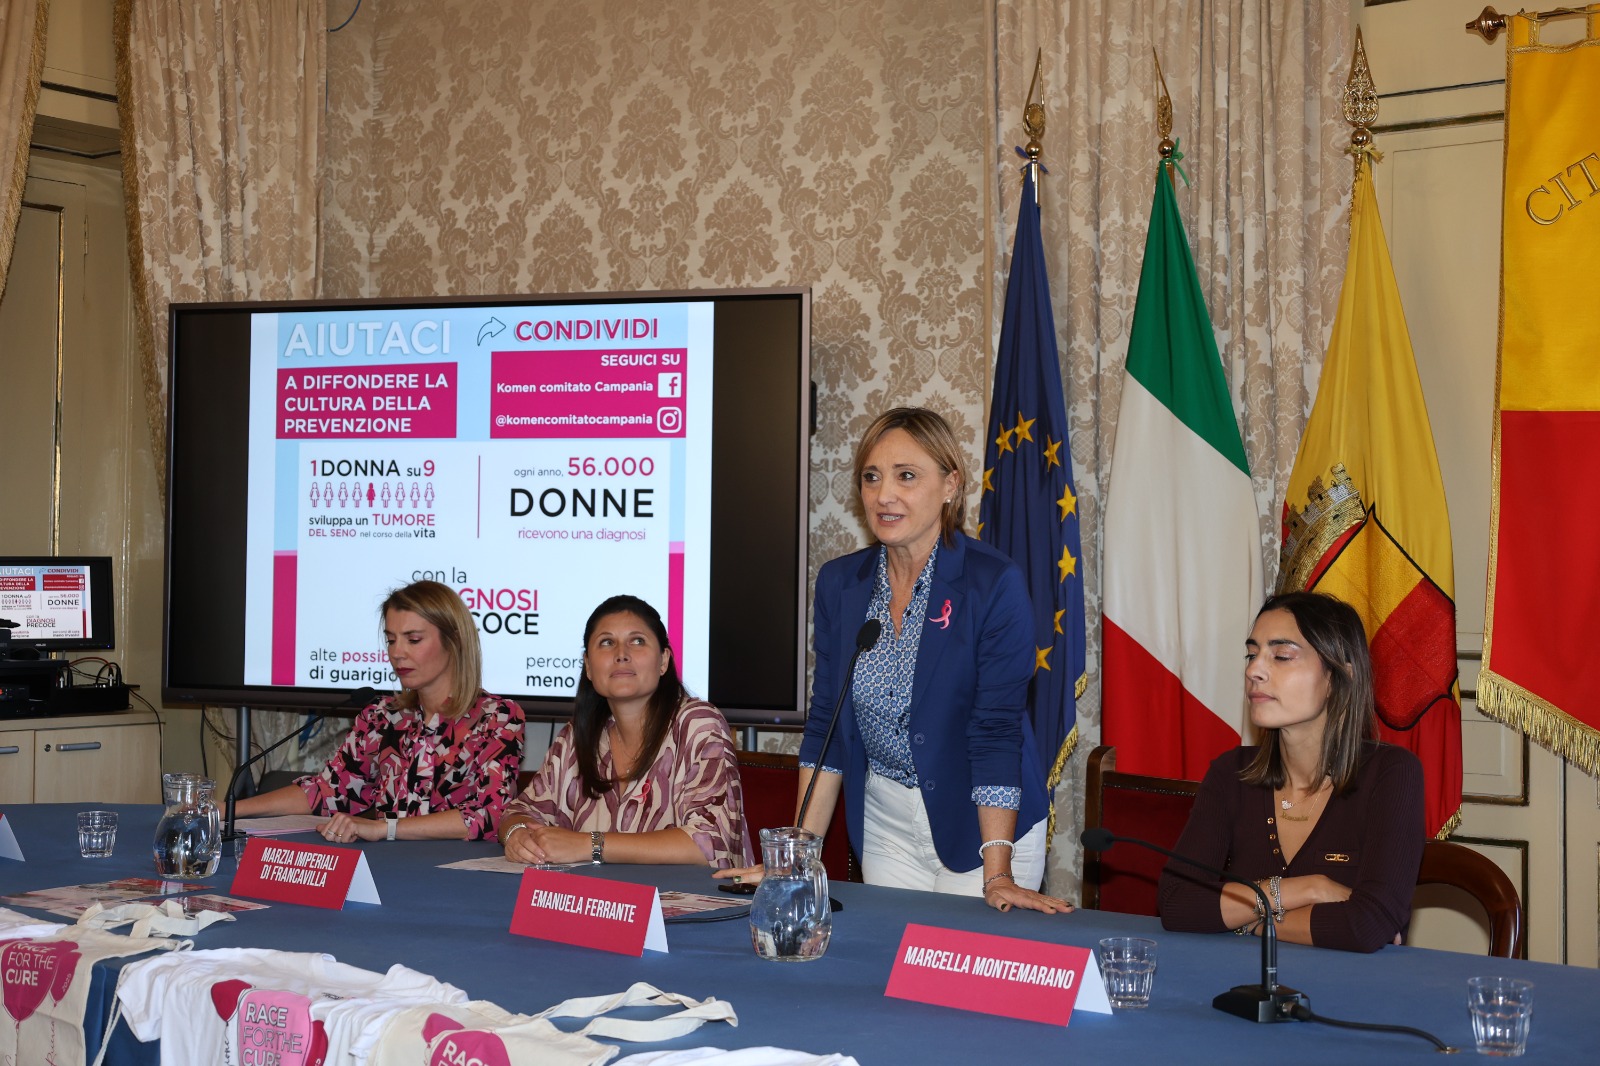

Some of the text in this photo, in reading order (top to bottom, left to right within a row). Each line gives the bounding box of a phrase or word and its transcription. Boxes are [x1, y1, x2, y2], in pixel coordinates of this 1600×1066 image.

[1526, 152, 1600, 225] CIT
[284, 320, 450, 357] AIUTACI
[514, 318, 658, 342] CONDIVIDI
[601, 353, 681, 367] SEGUICI SU
[284, 373, 448, 390] A DIFFONDERE LA
[497, 381, 654, 395] Komen comitato Campania
[284, 396, 431, 412] CULTURA DELLA
[284, 418, 412, 433] PREVENZIONE
[496, 414, 653, 427] @komencomitatocampania
[514, 456, 655, 478] ogni anno, 56.000
[510, 488, 654, 518] DONNE
[309, 514, 436, 527] sviluppa un TUMORE
[308, 528, 327, 537] DEL
[330, 528, 356, 538] SENO
[360, 530, 370, 538] nel
[394, 530, 412, 538] della
[414, 528, 436, 539] vita
[518, 528, 646, 542] ricevono una diagnosi
[412, 566, 466, 584] con la
[458, 588, 538, 611] GNOSI
[310, 648, 389, 664] alte possib
[526, 656, 584, 670] percors
[309, 666, 398, 684] di guarigio
[526, 675, 575, 688] meno
[260, 847, 340, 871] MARZIA IMPERIALI
[260, 864, 328, 888] DI FRANCAVILLA
[530, 889, 637, 923] EMANUELA FERRANTE
[8, 951, 56, 970] FOR THE
[904, 946, 1075, 990] MARCELLA MONTEMARANO
[6, 968, 38, 986] CURE
[245, 1002, 288, 1028] RACE
